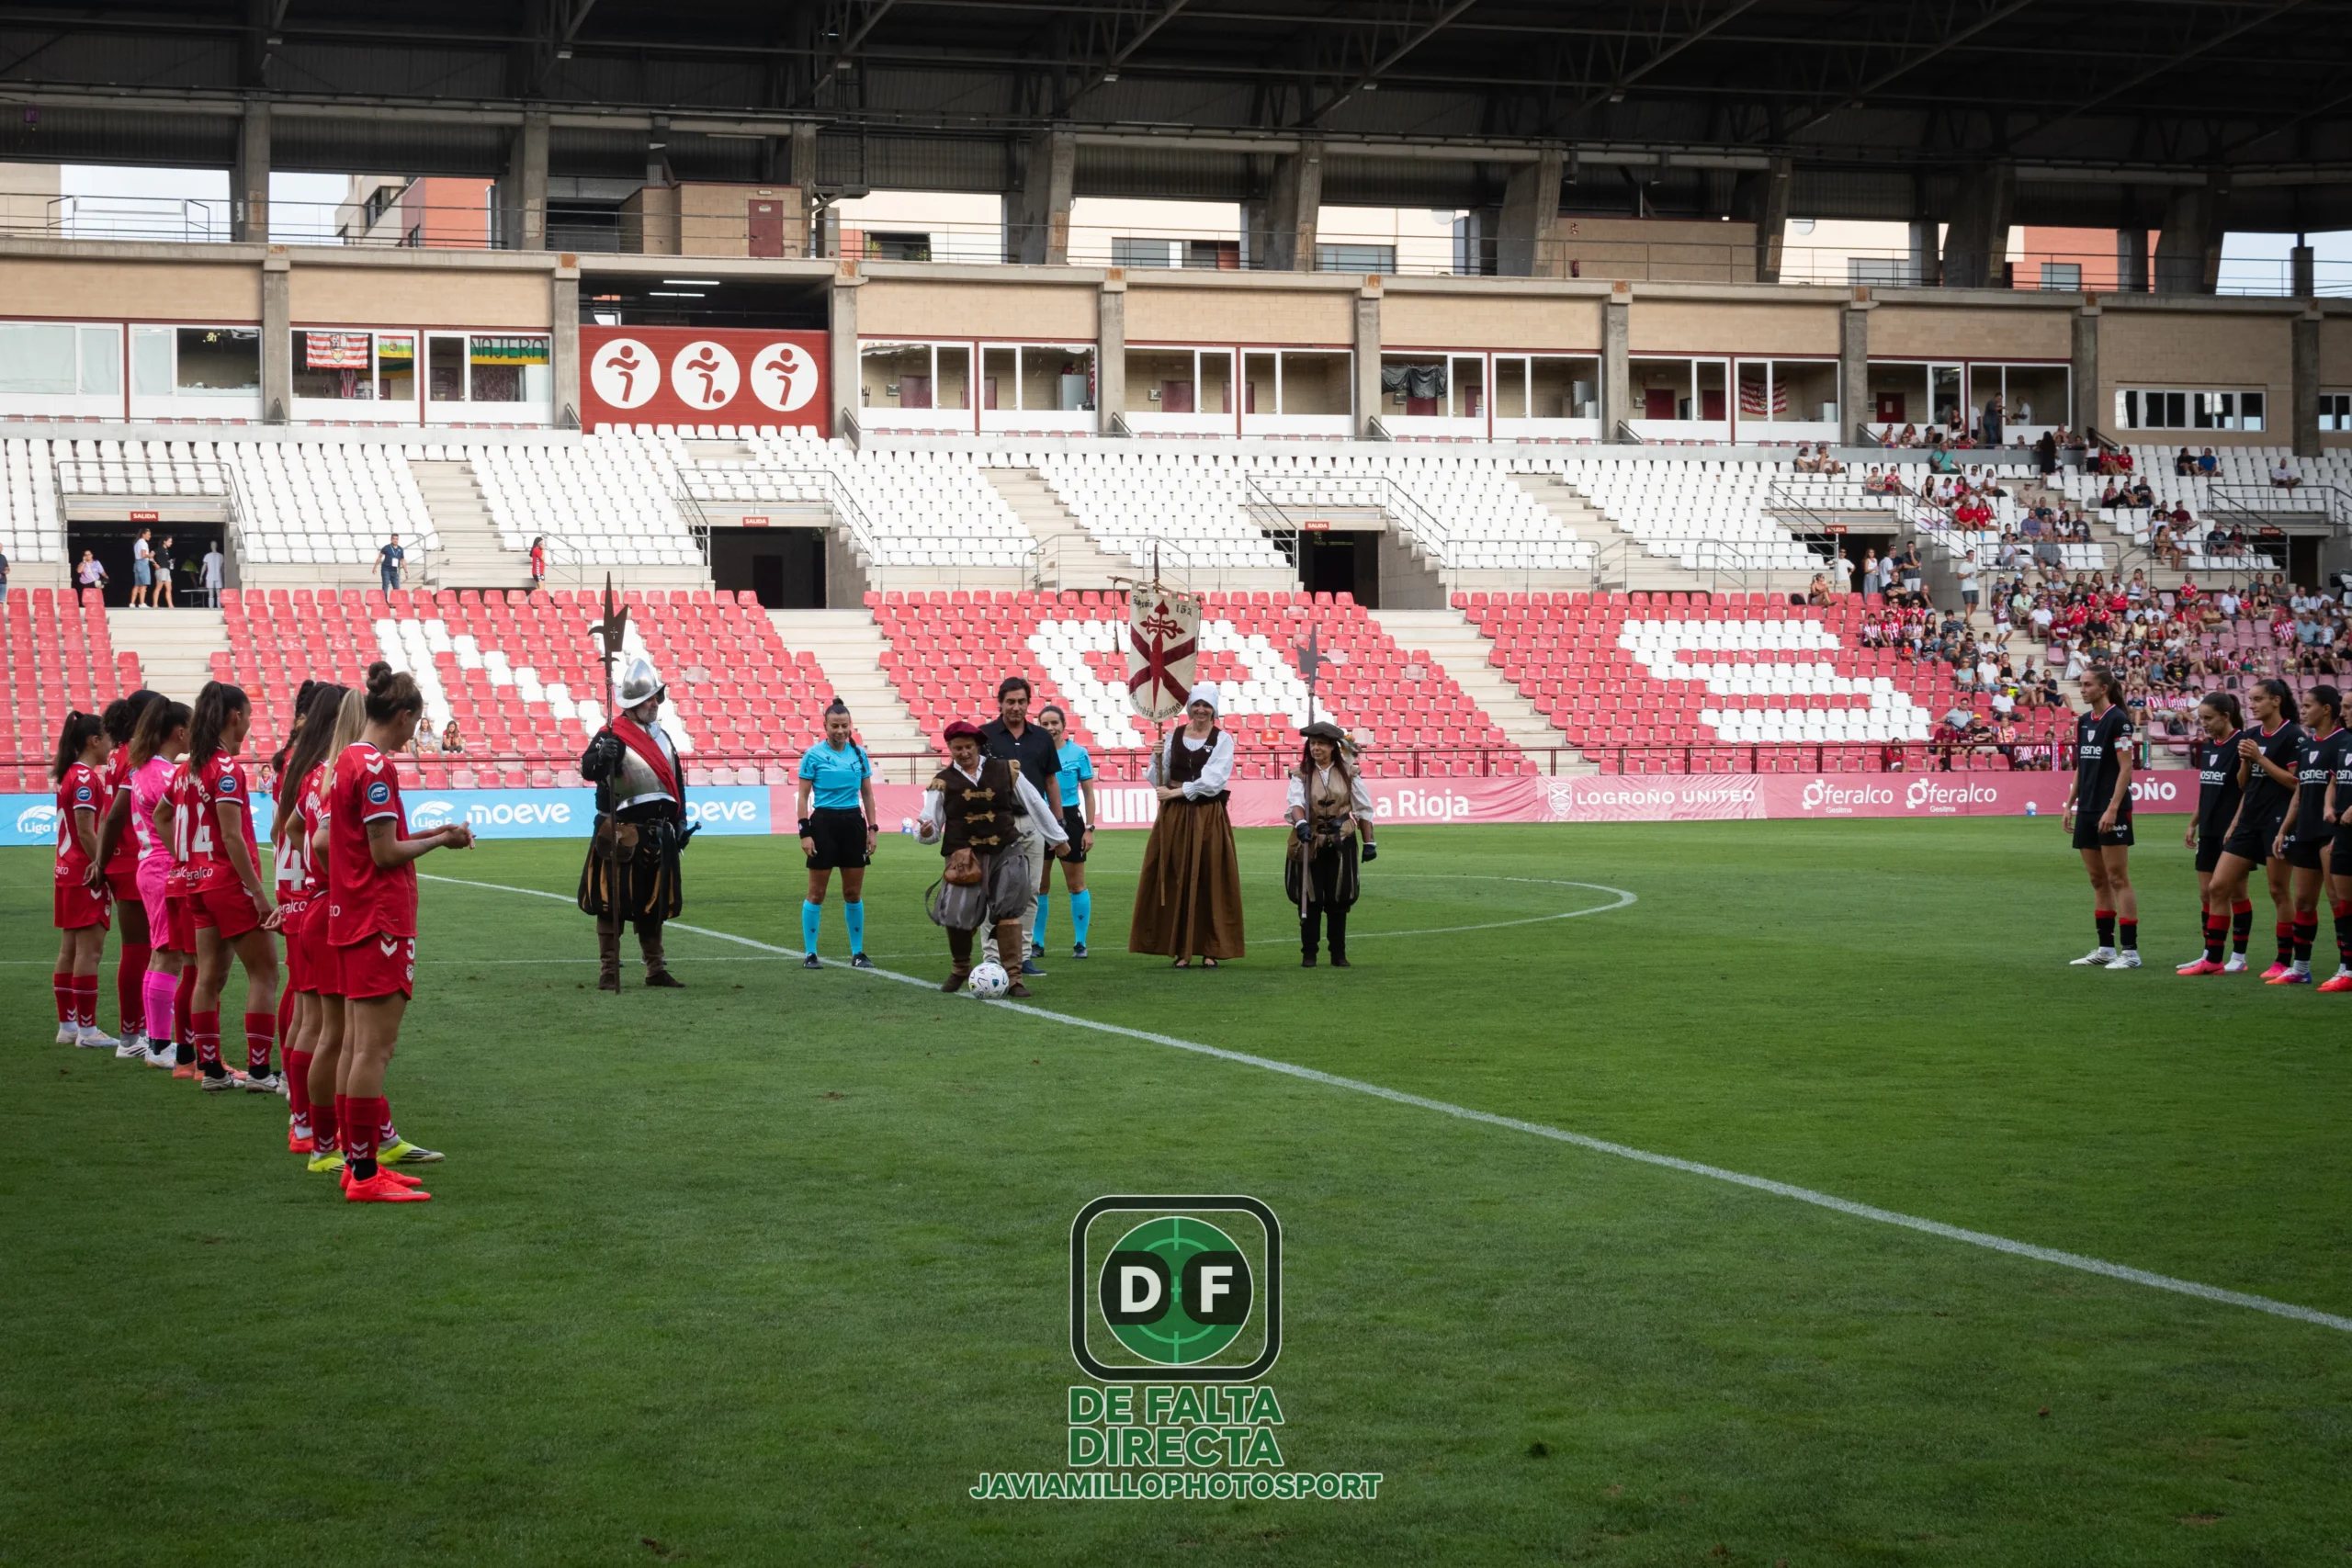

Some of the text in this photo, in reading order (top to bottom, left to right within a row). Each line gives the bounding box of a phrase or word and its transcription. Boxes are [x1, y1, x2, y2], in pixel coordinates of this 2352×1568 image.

[2201, 770, 2227, 782] osner
[1577, 788, 1756, 806] LOGROÑO UNITED
[1825, 784, 1894, 805] feralco
[1928, 783, 1997, 804] feralco
[466, 802, 571, 825] moeve
[685, 800, 756, 822] oeve
[1079, 788, 1158, 823] PUM
[1398, 788, 1469, 821] Rioja
[25, 821, 51, 834] Liga
[418, 817, 443, 829] Liga
